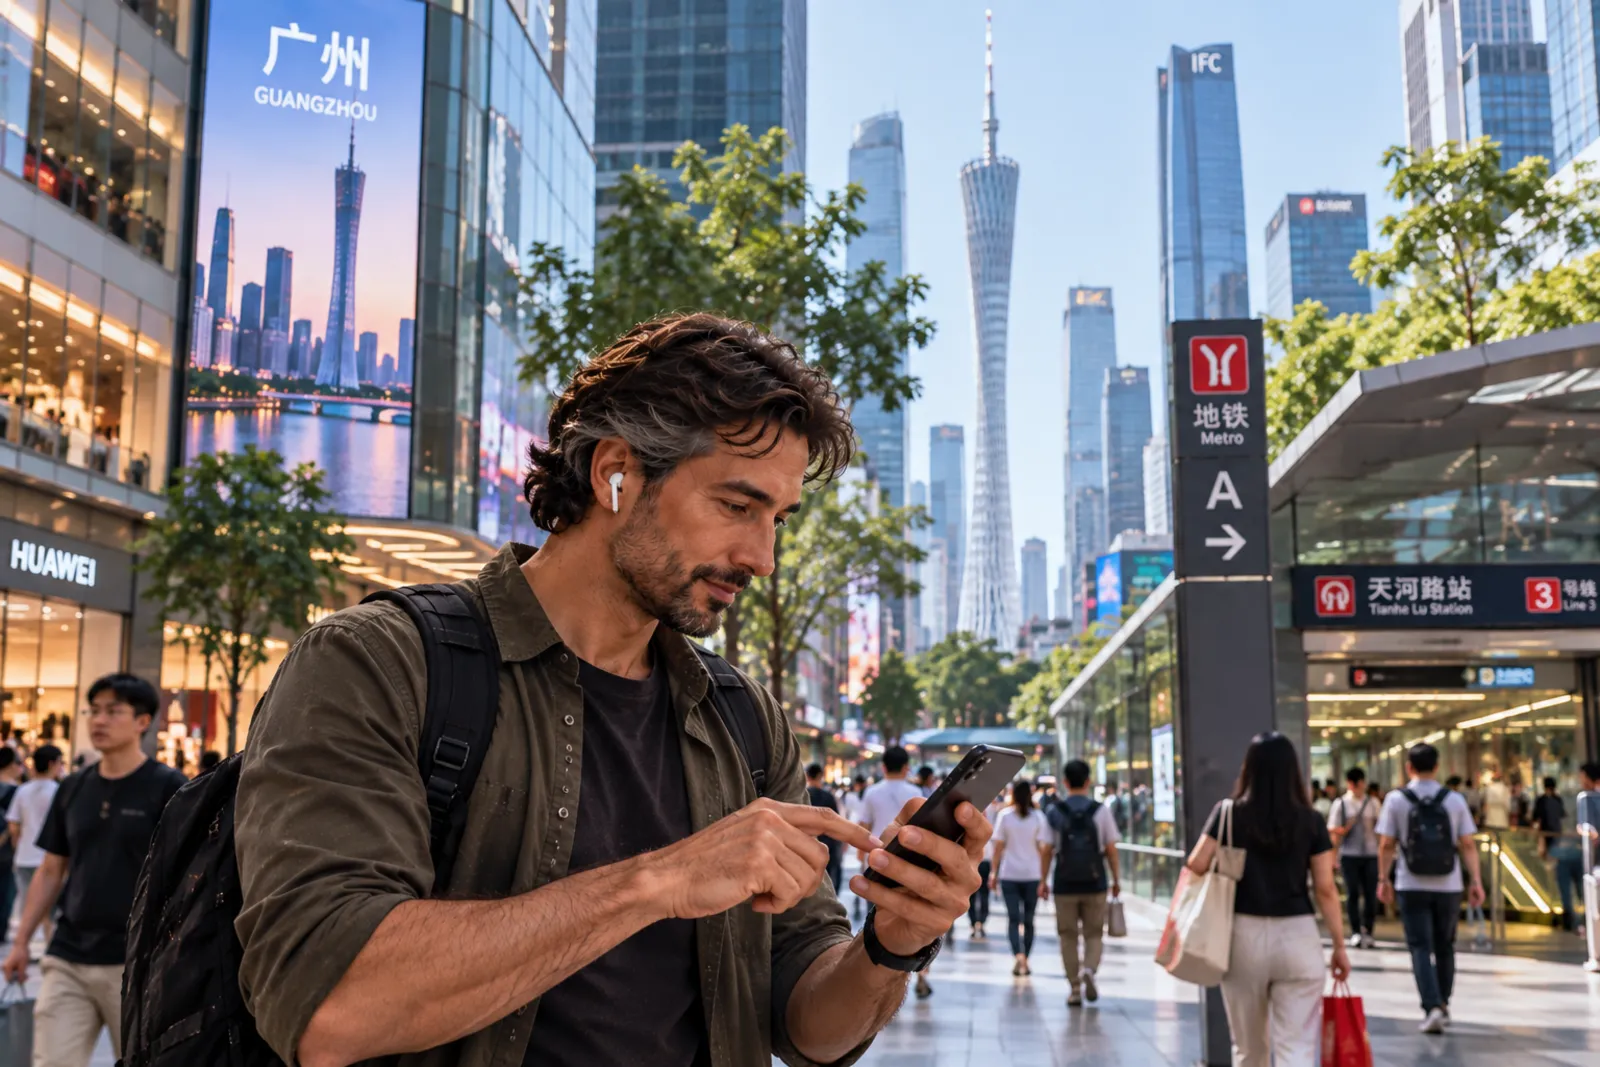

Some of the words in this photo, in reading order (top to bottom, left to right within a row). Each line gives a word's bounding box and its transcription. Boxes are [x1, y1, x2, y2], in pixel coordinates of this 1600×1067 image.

[262, 22, 370, 91] 广州
[1191, 52, 1222, 74] IFC
[254, 85, 377, 121] GUANGZHOU
[1193, 402, 1250, 429] 地铁
[1200, 431, 1244, 445] Metro
[1206, 470, 1243, 510] A
[10, 538, 97, 587] HUAWEI
[1368, 576, 1472, 601] 天河路站
[1534, 581, 1554, 610] 3
[1368, 603, 1409, 615] Tianhe
[1412, 603, 1427, 615] Lu
[1430, 602, 1473, 616] Station
